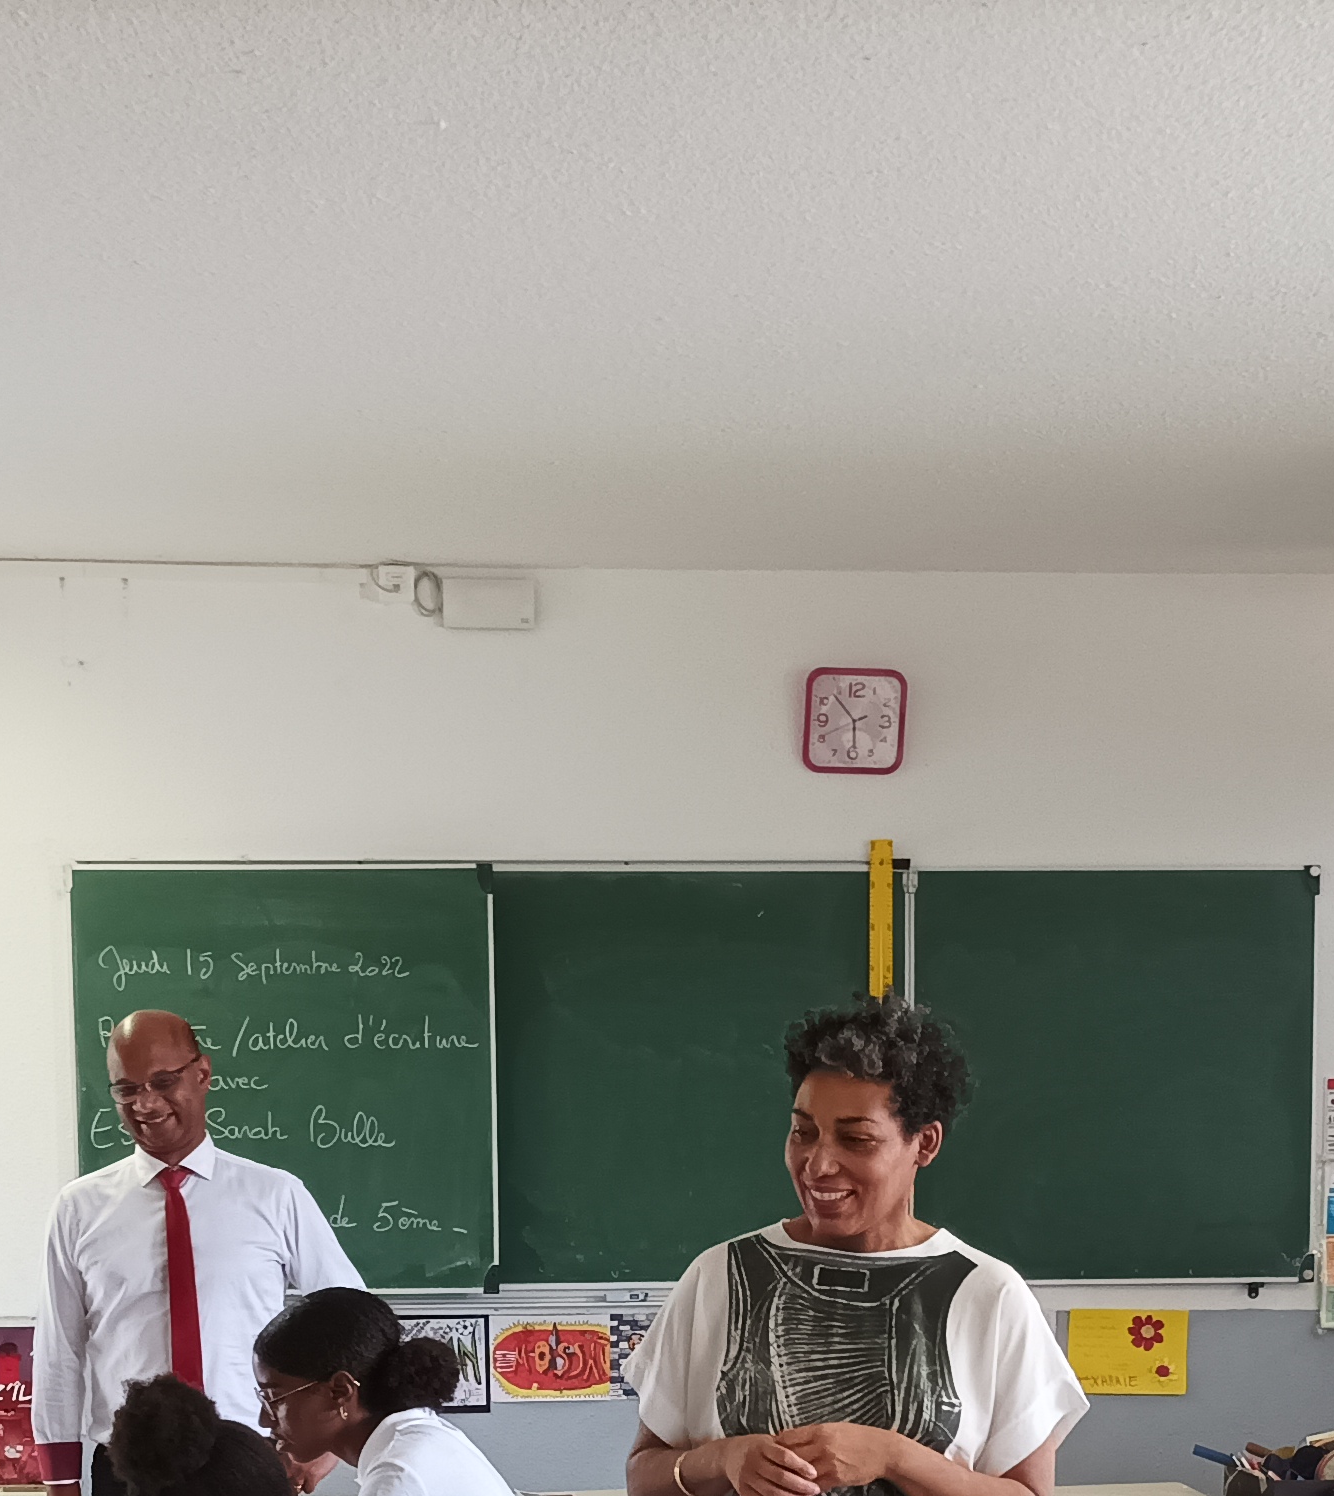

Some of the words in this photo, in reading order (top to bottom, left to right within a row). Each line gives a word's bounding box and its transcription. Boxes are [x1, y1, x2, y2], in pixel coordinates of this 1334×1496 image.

[848, 682, 866, 698] 12
[816, 713, 829, 728] 9
[878, 714, 892, 729] 3
[98, 945, 171, 991] Jeudi
[186, 948, 214, 980] 15
[231, 948, 341, 985] Septembre
[348, 952, 410, 978] 2022
[344, 1014, 479, 1050] d'écriture
[208, 1073, 269, 1091] avec
[310, 1104, 395, 1149] Bulle
[329, 1194, 357, 1227] de
